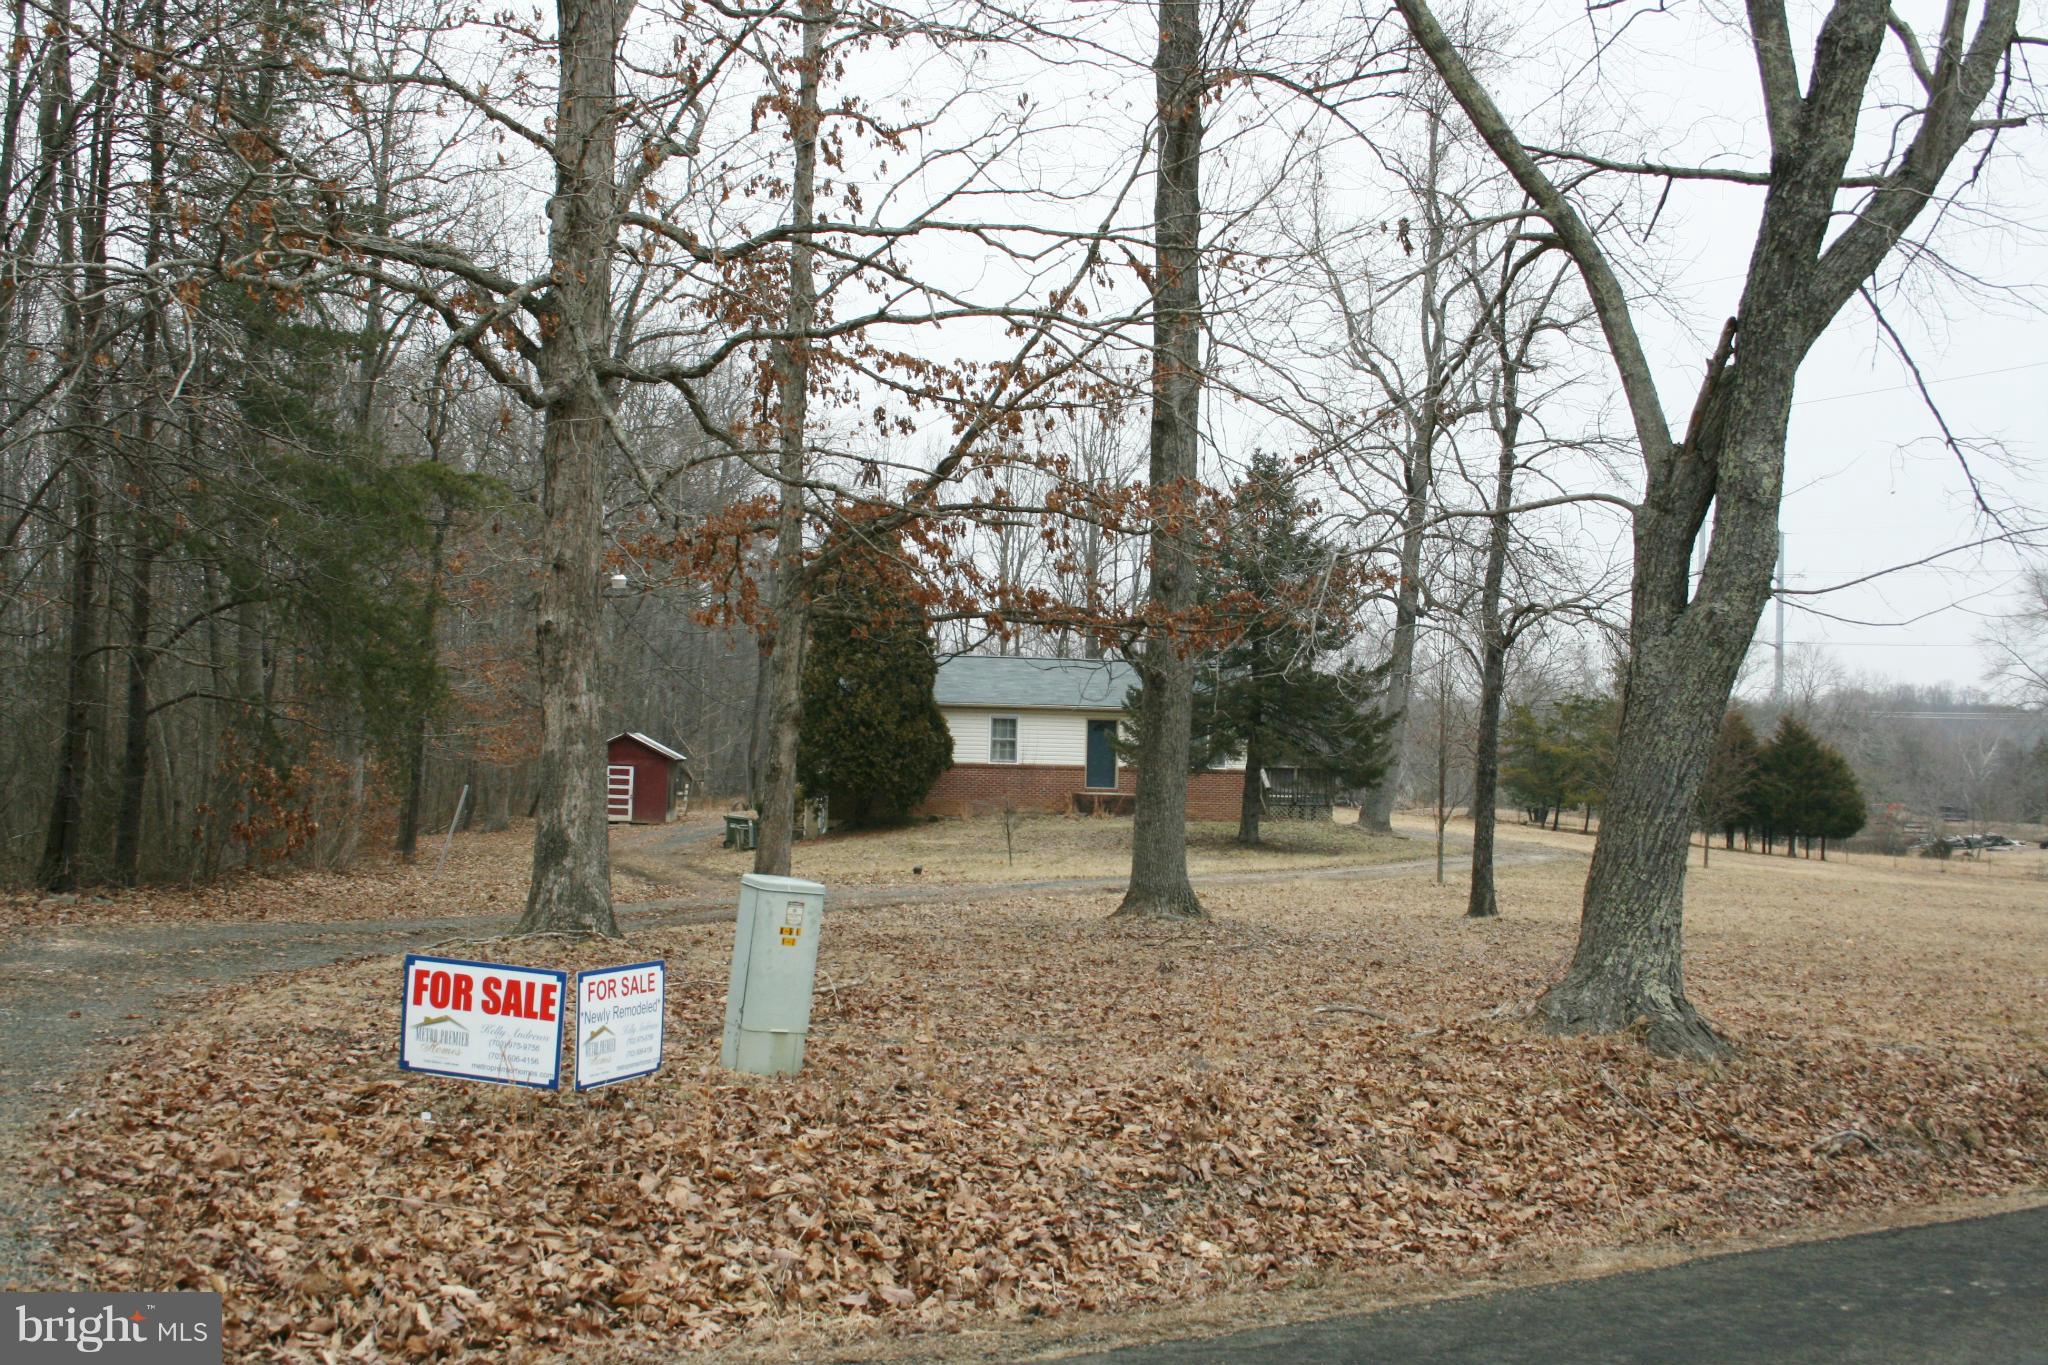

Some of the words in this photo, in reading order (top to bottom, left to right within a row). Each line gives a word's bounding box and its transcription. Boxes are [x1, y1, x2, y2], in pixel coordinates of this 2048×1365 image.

[413, 969, 474, 1011] FOR
[481, 976, 558, 1021] SALE
[588, 979, 616, 1003] FOR
[621, 972, 656, 997] SALE
[415, 1026, 438, 1042] METRO
[440, 1030, 470, 1047] PREMIER
[480, 1023, 505, 1039] Kelly
